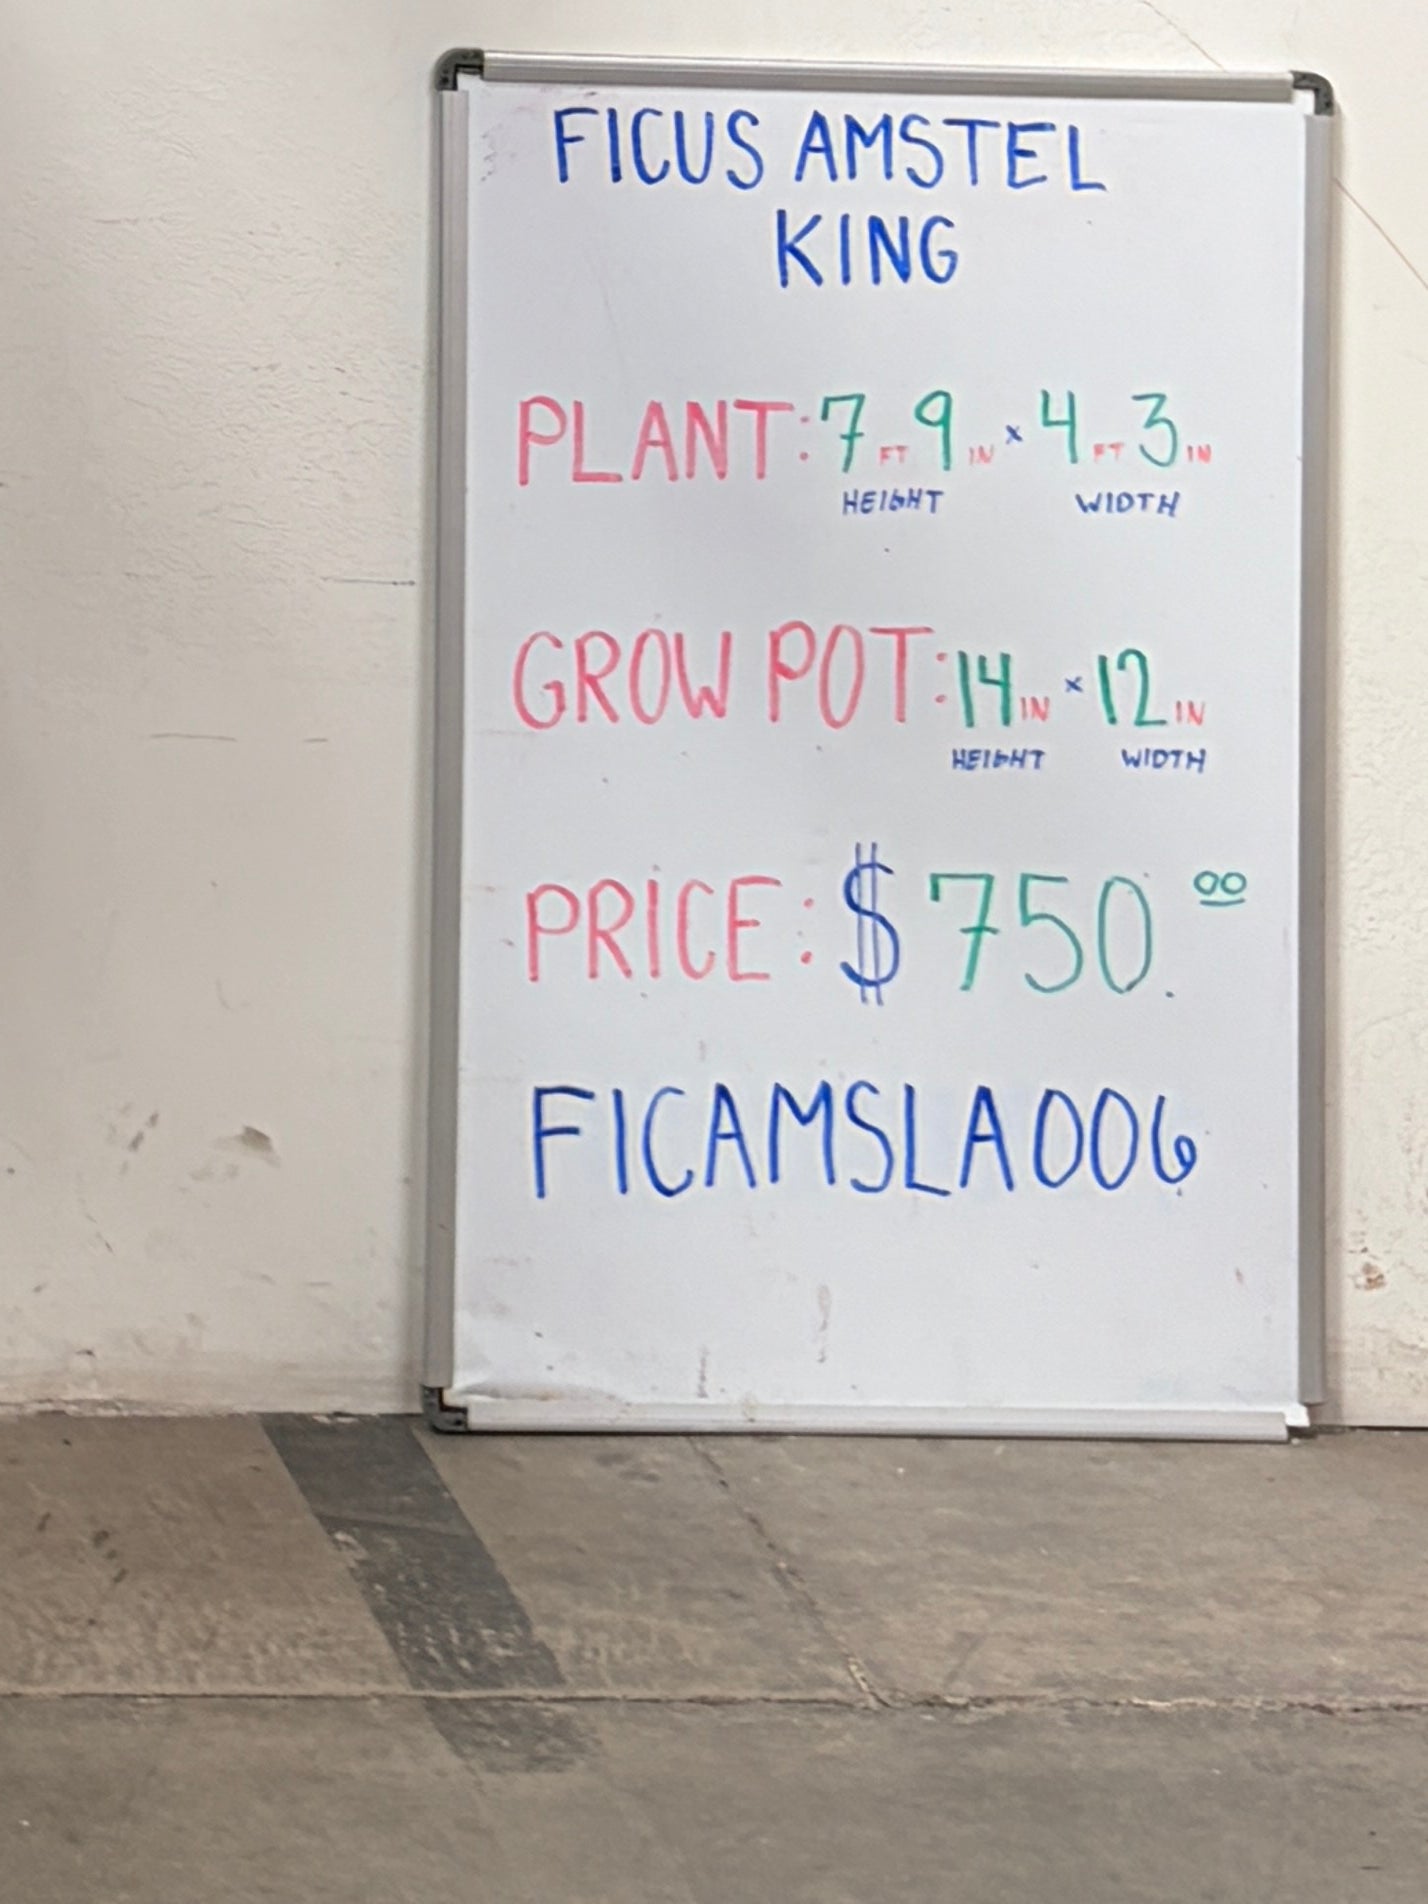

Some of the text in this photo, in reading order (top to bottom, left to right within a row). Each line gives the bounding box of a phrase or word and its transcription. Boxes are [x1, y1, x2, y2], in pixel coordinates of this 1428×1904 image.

[552, 106, 1107, 193] FICUS AMSTEL
[774, 208, 960, 290] KING
[516, 392, 812, 489] PLANT:
[819, 392, 867, 473] 7
[912, 389, 954, 472] 9
[1038, 390, 1080, 465] 4
[1131, 392, 1180, 469] 3
[842, 488, 1181, 518] HEIGHT WIDTH
[511, 628, 734, 732] GROW
[766, 620, 948, 731] POT:
[956, 650, 1014, 729] 14
[1096, 648, 1169, 729] 12
[950, 747, 1207, 774] HEIGHT WIDTH
[524, 874, 815, 985] PRICE:
[531, 1078, 1199, 1201] FICAMSLA006
